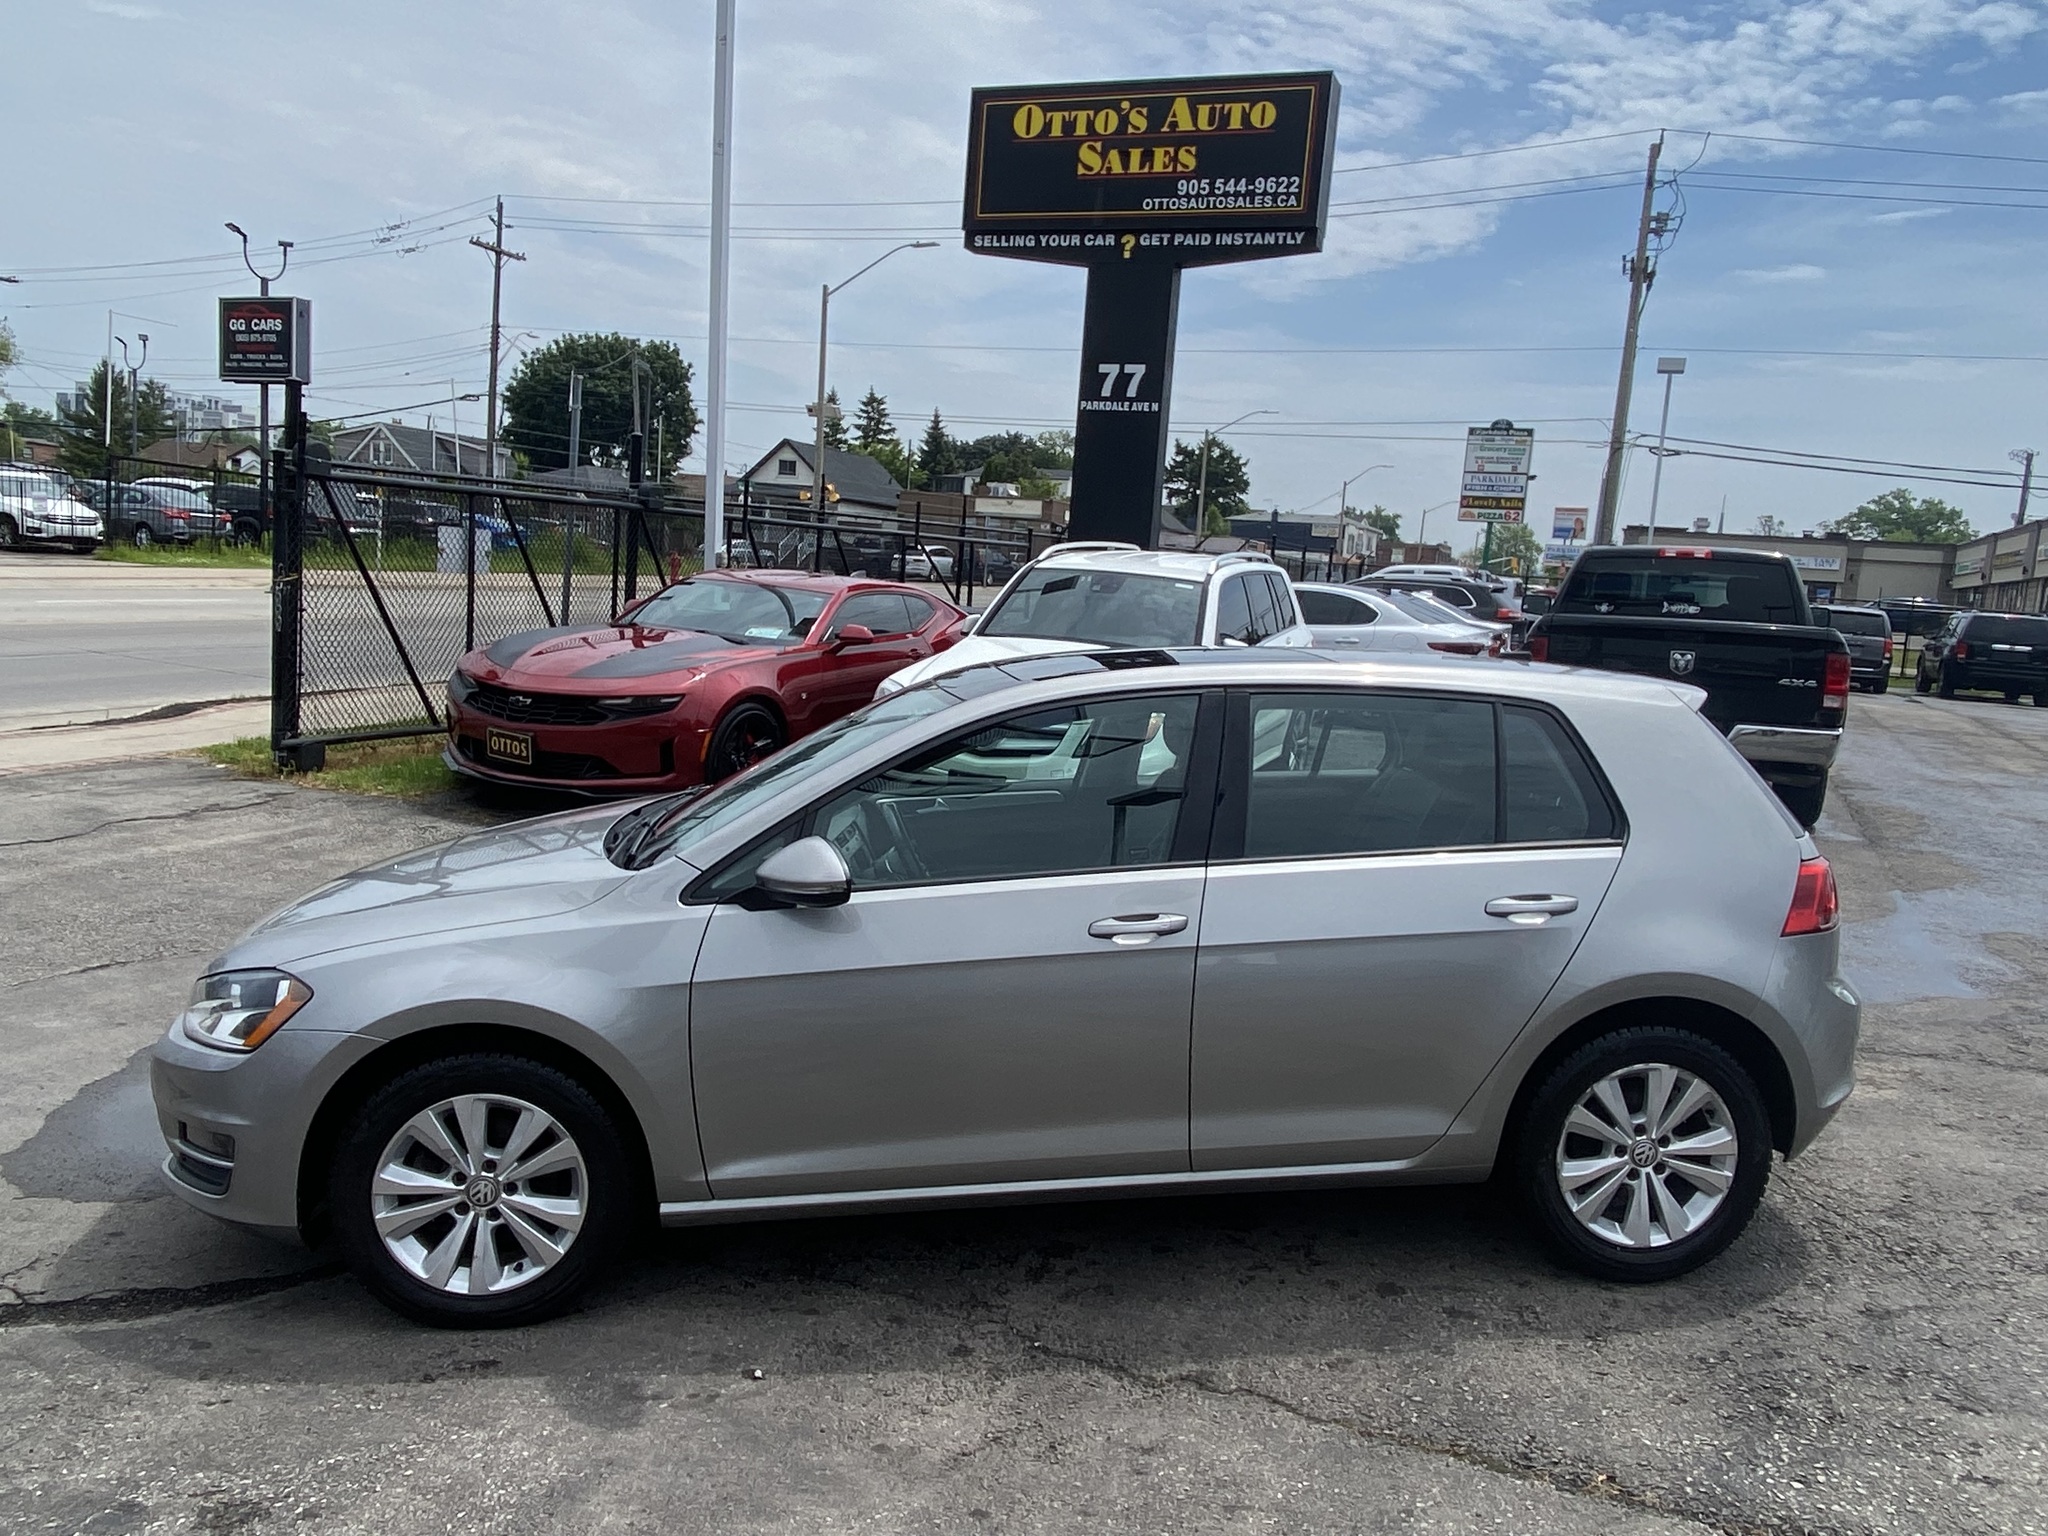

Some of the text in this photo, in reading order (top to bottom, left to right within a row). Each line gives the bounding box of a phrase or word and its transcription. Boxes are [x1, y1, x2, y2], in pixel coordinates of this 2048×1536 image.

[1013, 97, 1277, 139] OTTO'S AUTO
[1077, 141, 1197, 175] SALES
[1177, 176, 1300, 196] 905 544-9622
[1142, 195, 1298, 211] OTTOSAUTOSALES.CA
[974, 235, 1036, 247] SELLING
[1040, 235, 1080, 247] YOUR
[1084, 234, 1115, 246] CAR
[1139, 233, 1171, 246] GET
[1174, 233, 1212, 246] PAID
[1215, 231, 1306, 245] INSTANTLY
[229, 319, 283, 331] GG CARS
[1098, 363, 1146, 398] 77
[1080, 400, 1159, 412] PARKDALE AVE N
[1470, 475, 1520, 485] PARKDALE
[1477, 511, 1520, 521] PIZZA 62
[492, 737, 527, 757] OTTOS
